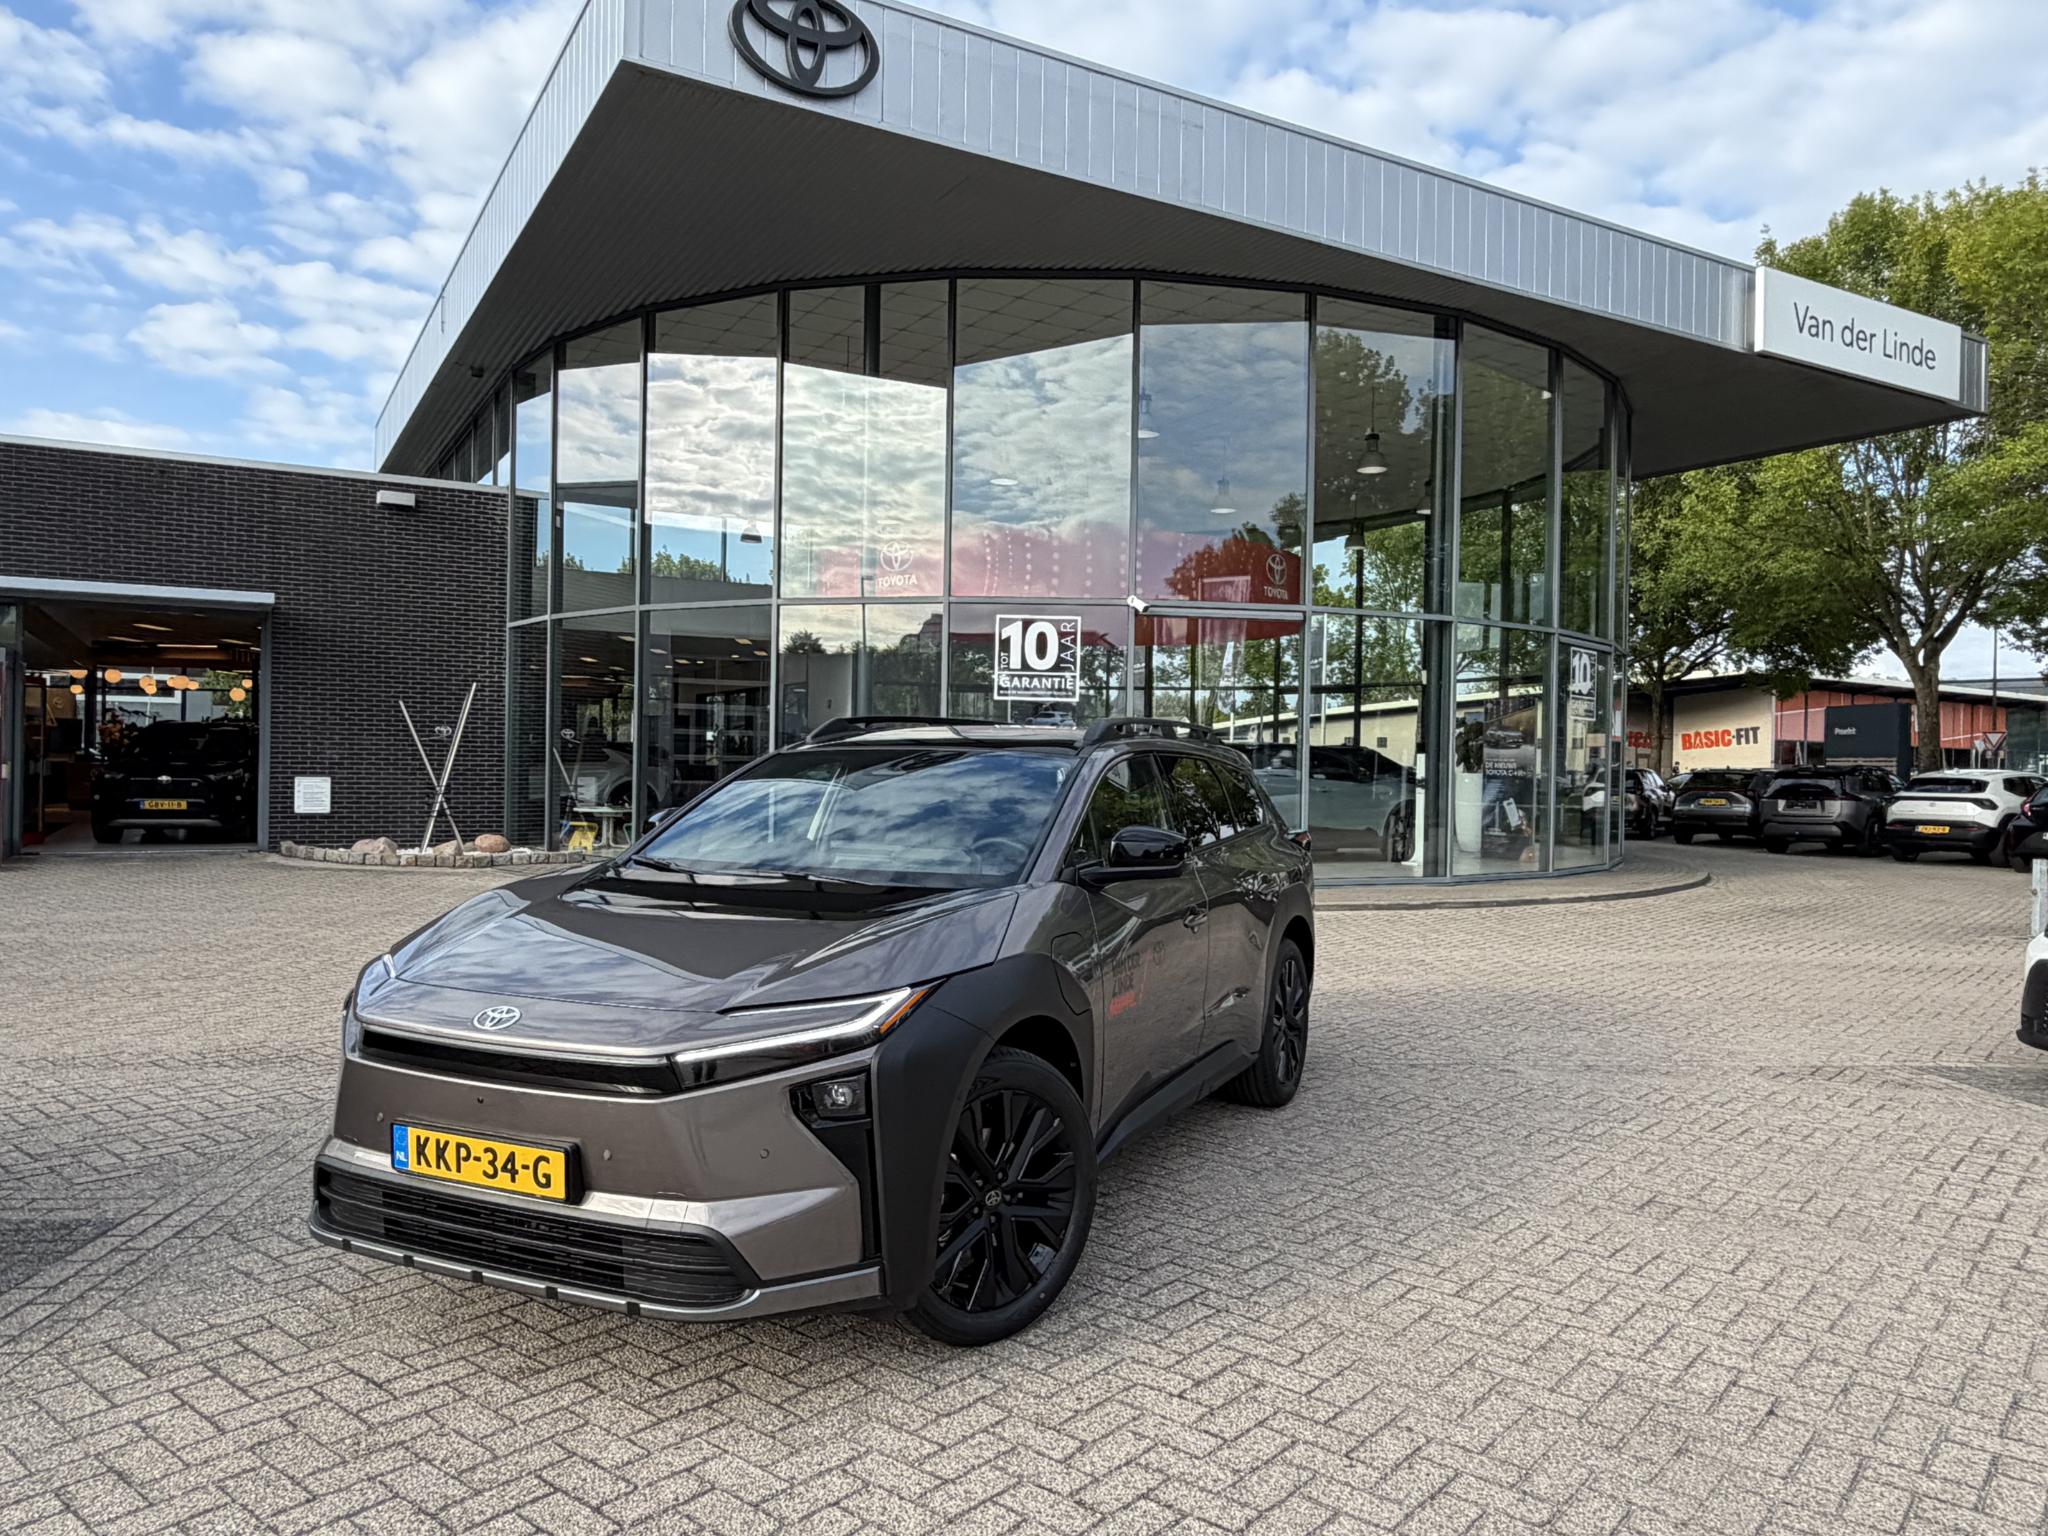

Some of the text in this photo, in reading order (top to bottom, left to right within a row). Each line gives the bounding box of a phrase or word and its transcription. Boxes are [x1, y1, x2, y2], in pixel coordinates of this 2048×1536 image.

[1794, 302, 1936, 370] Van der Linde
[879, 574, 918, 587] TOYOTA
[1263, 586, 1289, 600] TOYOTA
[1000, 651, 1009, 669] TOT
[1001, 620, 1059, 670] 10
[1060, 622, 1076, 671] JAAR
[999, 676, 1075, 689] GARANTIE
[395, 1134, 552, 1190] NL KKP-34-G
